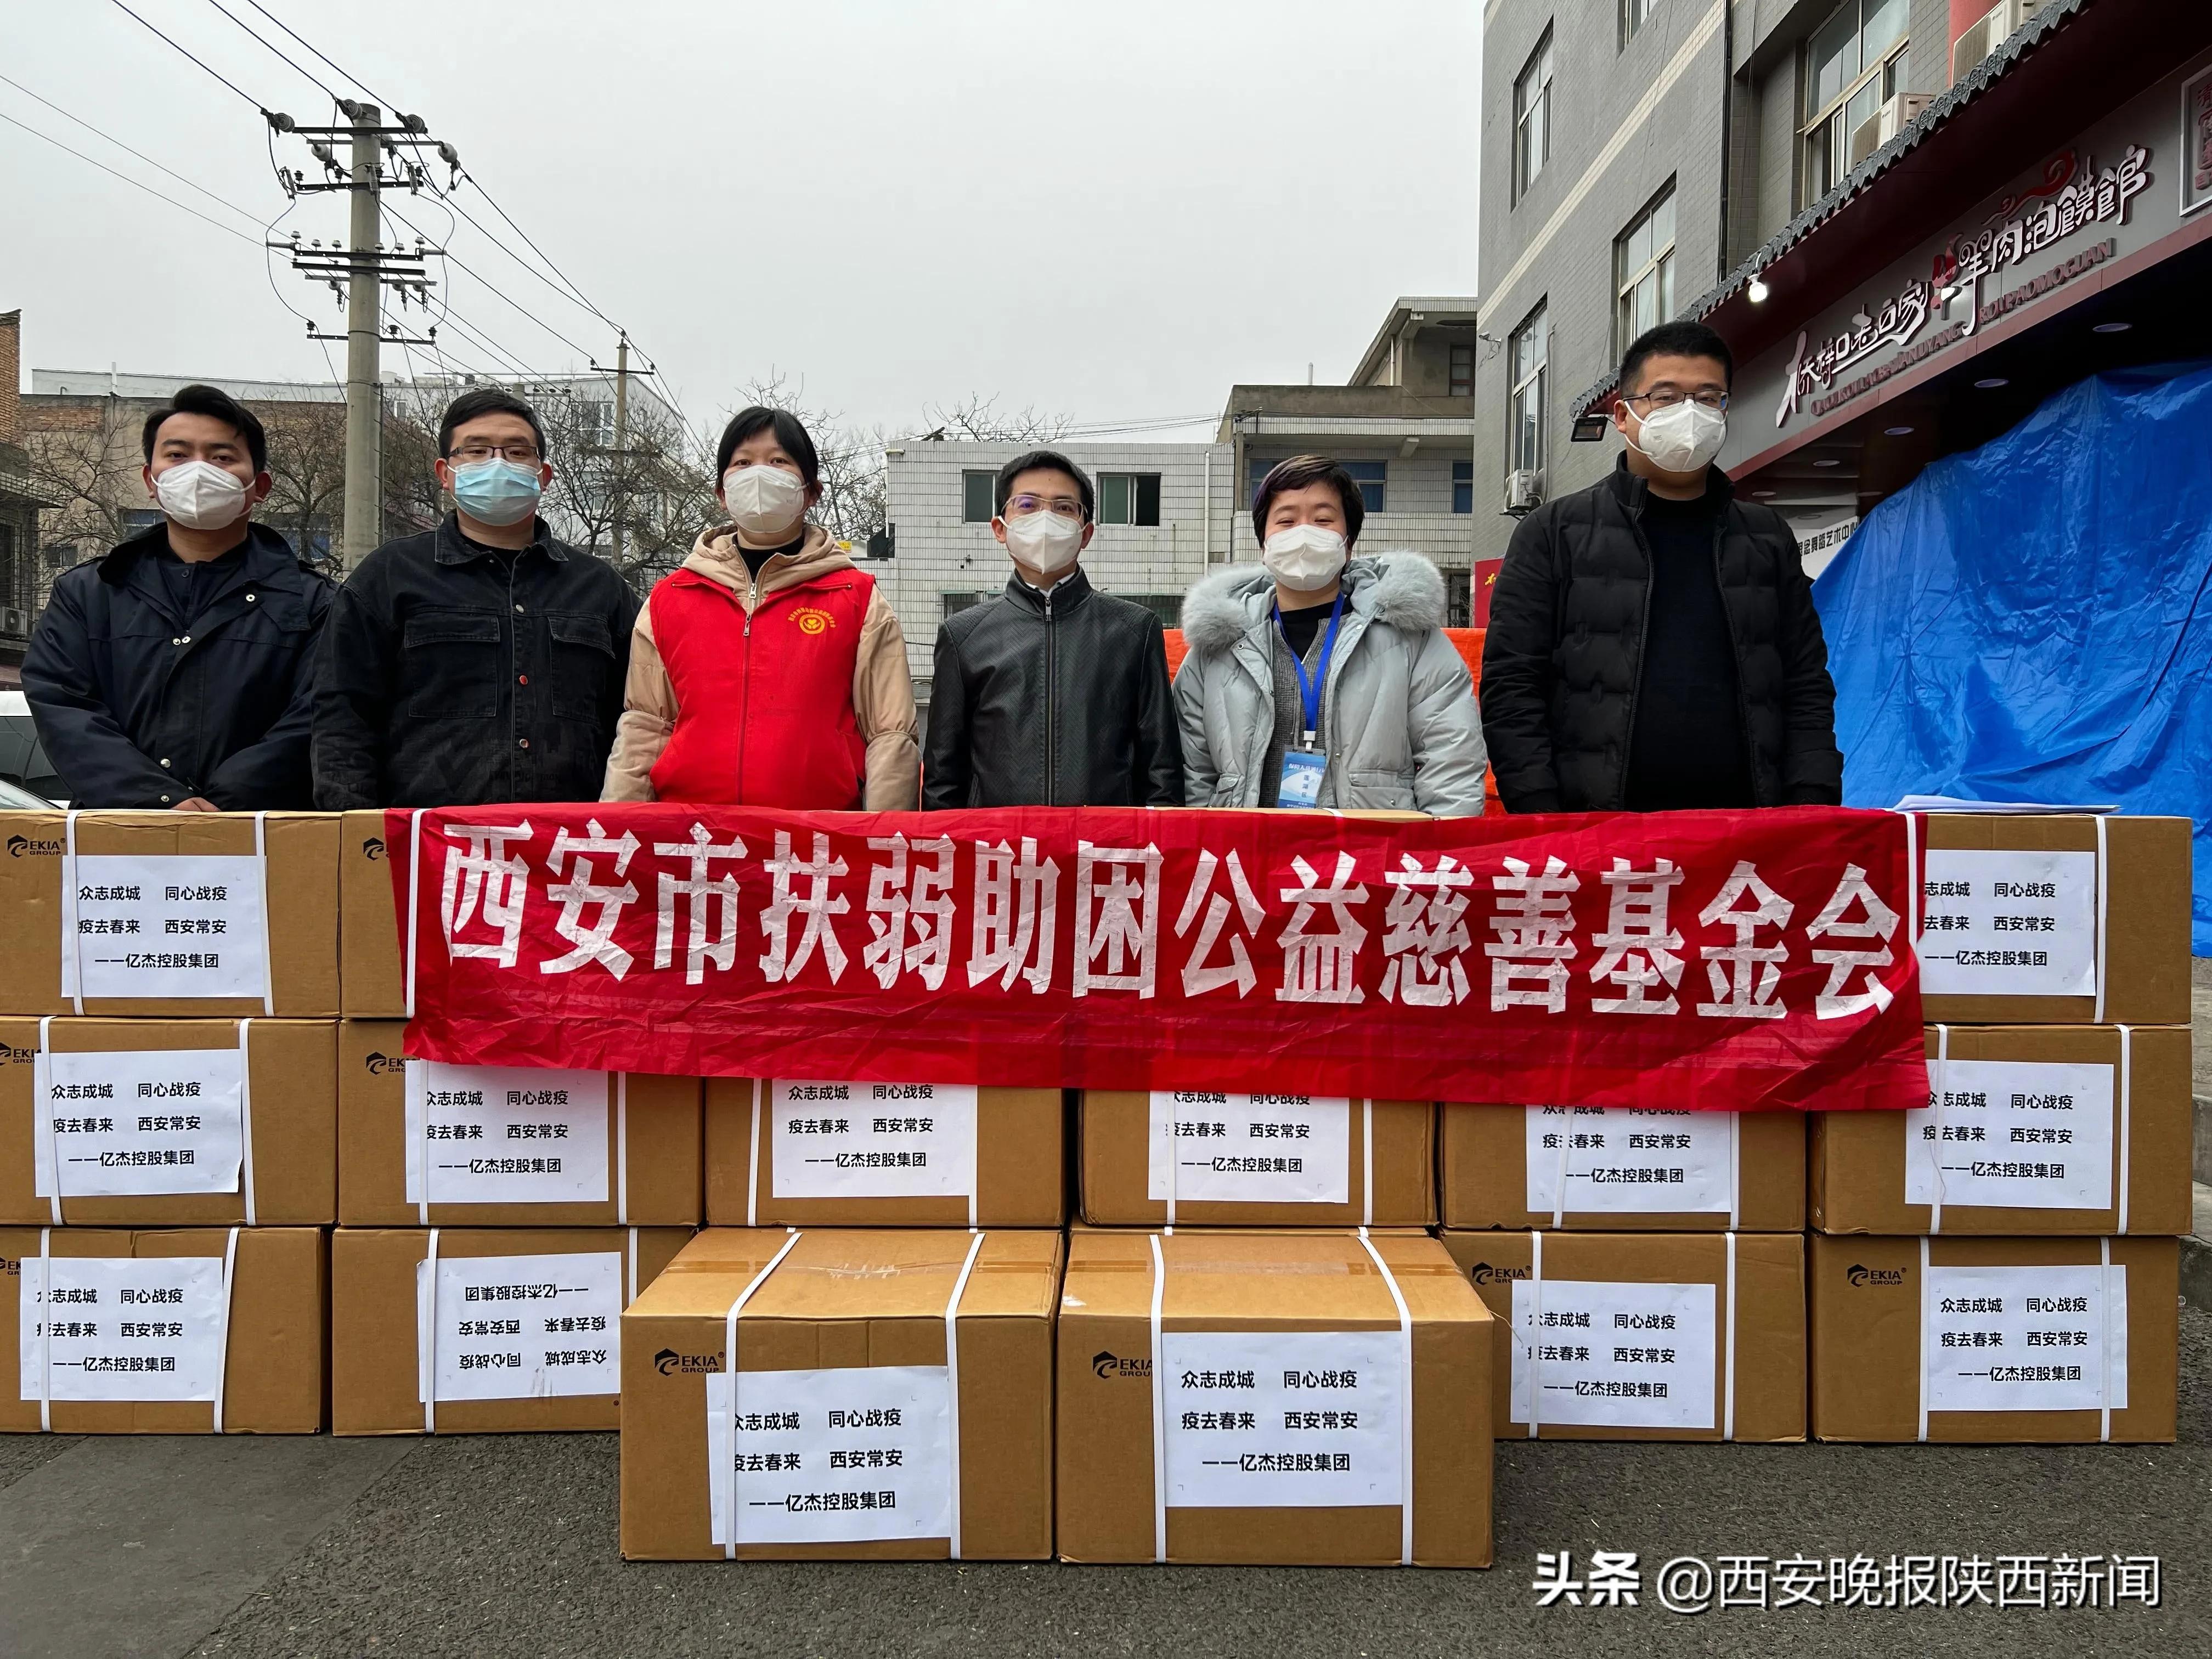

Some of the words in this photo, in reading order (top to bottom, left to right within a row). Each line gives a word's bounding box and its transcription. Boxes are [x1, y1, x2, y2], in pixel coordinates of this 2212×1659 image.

[80, 886, 140, 900] 众志成城
[166, 886, 227, 900] 同心战疫
[1926, 882, 1970, 896] 志成城
[1995, 883, 2055, 898] 同心战疫
[78, 919, 140, 934] 疫去春来
[165, 919, 226, 934] 西安常安
[441, 819, 1900, 1020] 西安市扶弱助困公益慈善基金会
[1925, 917, 1969, 930] 去春来
[1994, 917, 2055, 931] 西安常安
[52, 1084, 113, 1099] 众志成城
[138, 1082, 200, 1097] 同心战疫
[507, 1090, 568, 1105] 同心战疫
[789, 1085, 849, 1100] 众志成城
[873, 1084, 933, 1099] 同心战疫
[2011, 1094, 2073, 1109] 同心战疫
[138, 1116, 200, 1131] 西安常安
[507, 1124, 568, 1138] 西安常安
[789, 1119, 849, 1133] 疫去春来
[873, 1118, 933, 1132] 西安常安
[1250, 1124, 1309, 1138] 西安常安
[1629, 1134, 1690, 1148] 西安常安
[2011, 1128, 2072, 1143] 西安常安
[121, 1289, 183, 1304] 同心战疫
[1941, 1298, 2002, 1312] 众志成城
[2027, 1297, 2087, 1312] 同心战疫
[459, 1320, 520, 1336] 西安常安
[545, 1316, 606, 1333] 疫去春来
[1615, 1314, 1675, 1329] 同心战疫
[121, 1322, 182, 1337] 西安常安
[1942, 1332, 2002, 1347] 疫去春来
[2027, 1331, 2087, 1346] 西安常安
[460, 1353, 521, 1369] 同心战疫
[545, 1350, 606, 1366] 众志成城
[1614, 1348, 1674, 1363] 西安常安
[1182, 1370, 1255, 1388] 众志成城
[1284, 1370, 1357, 1388] 同心战疫
[829, 1408, 901, 1427] 同心战疫
[1182, 1412, 1255, 1429] 疫去春来
[1284, 1411, 1357, 1429] 西安常安
[830, 1449, 902, 1468] 西安常安
